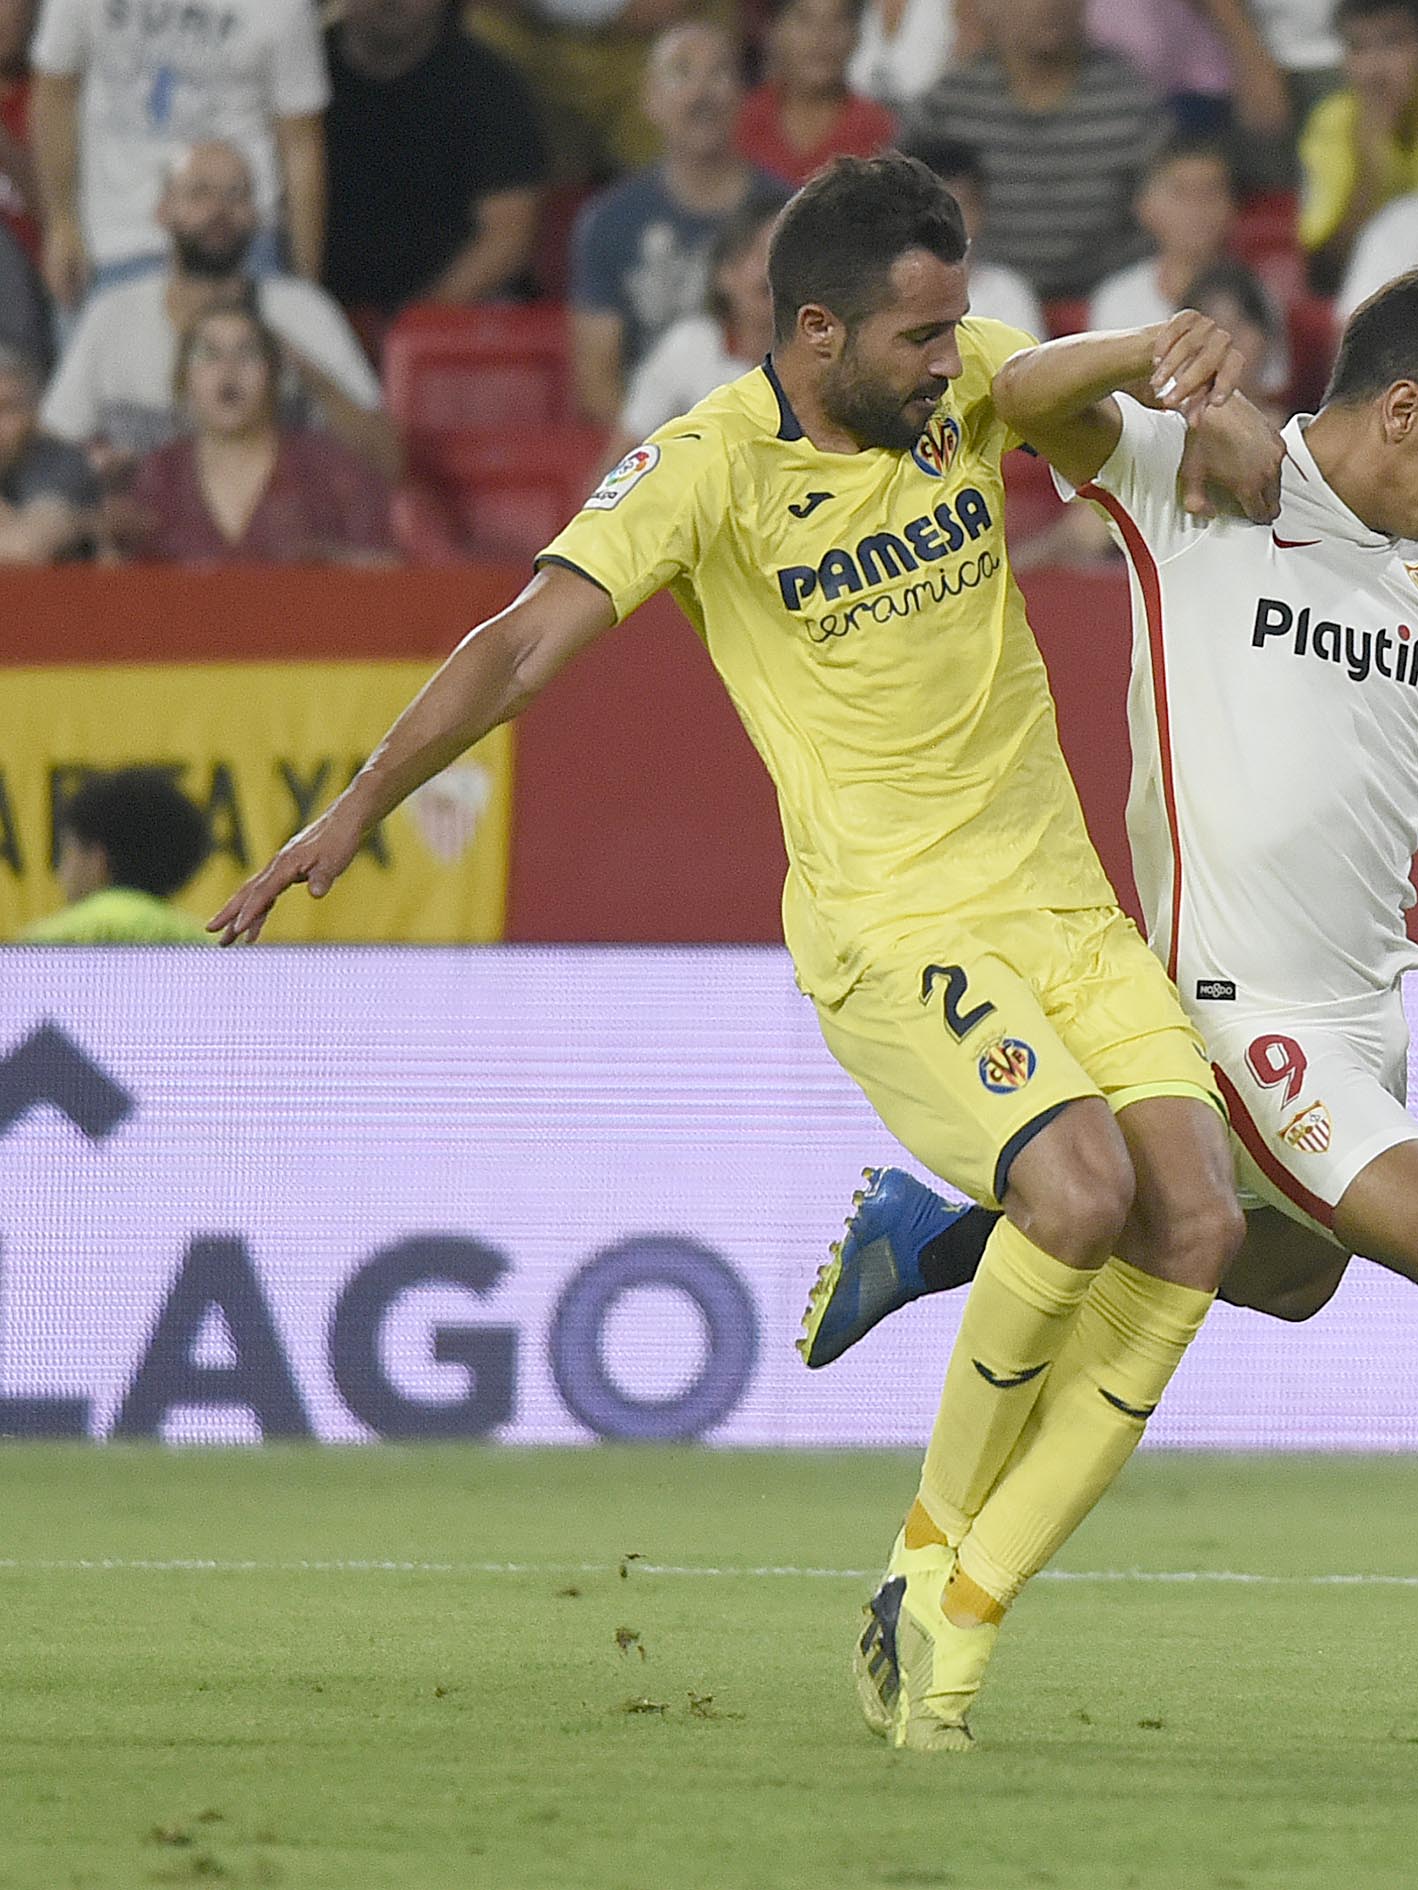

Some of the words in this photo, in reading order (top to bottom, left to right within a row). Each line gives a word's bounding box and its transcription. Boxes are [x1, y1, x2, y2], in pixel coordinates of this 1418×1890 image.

[777, 487, 992, 611] PAMESA
[805, 551, 999, 643] ceramica
[918, 964, 998, 1045] 2
[1244, 1033, 1308, 1111] 9
